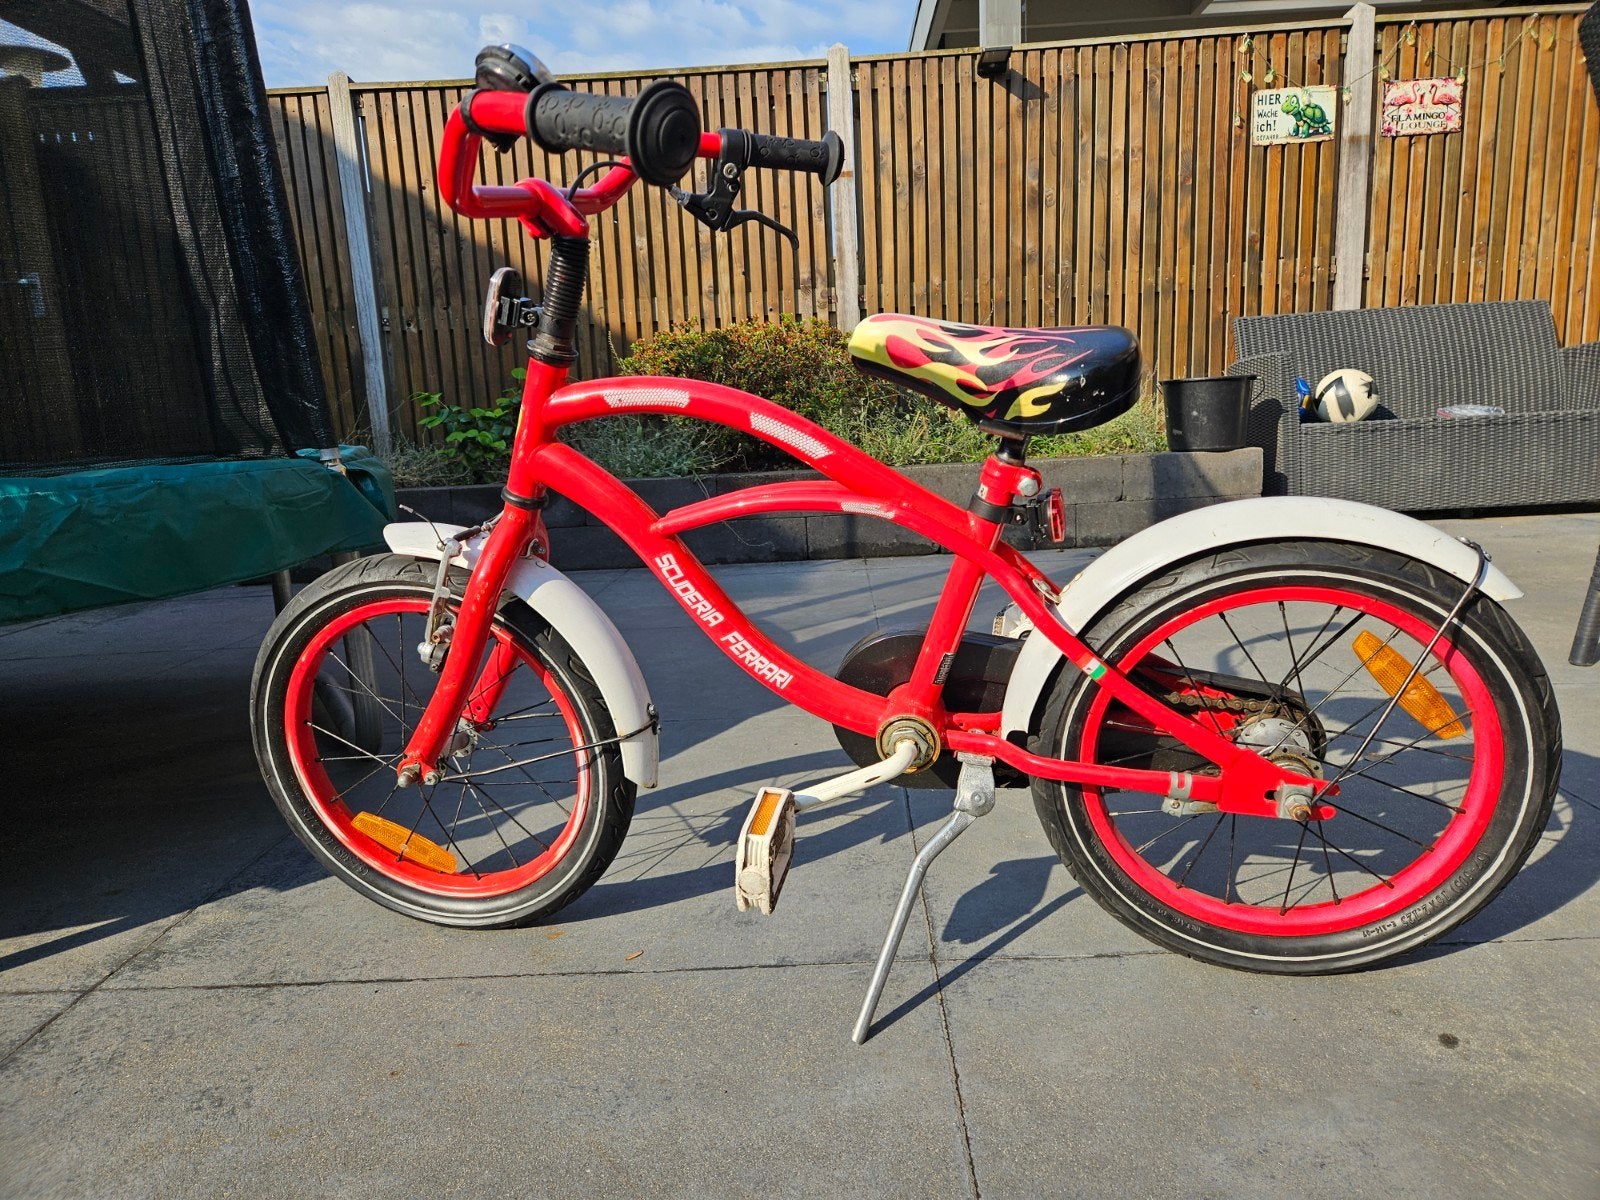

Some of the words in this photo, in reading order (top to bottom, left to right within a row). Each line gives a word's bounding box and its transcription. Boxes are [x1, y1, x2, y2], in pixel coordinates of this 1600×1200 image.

[1257, 93, 1281, 106] HIER
[1391, 112, 1446, 122] FLAMINGO
[1256, 120, 1276, 132] ich!
[1401, 120, 1446, 130] LOUNGE
[655, 553, 725, 627] SCUDERIA
[720, 631, 794, 690] FERRARI
